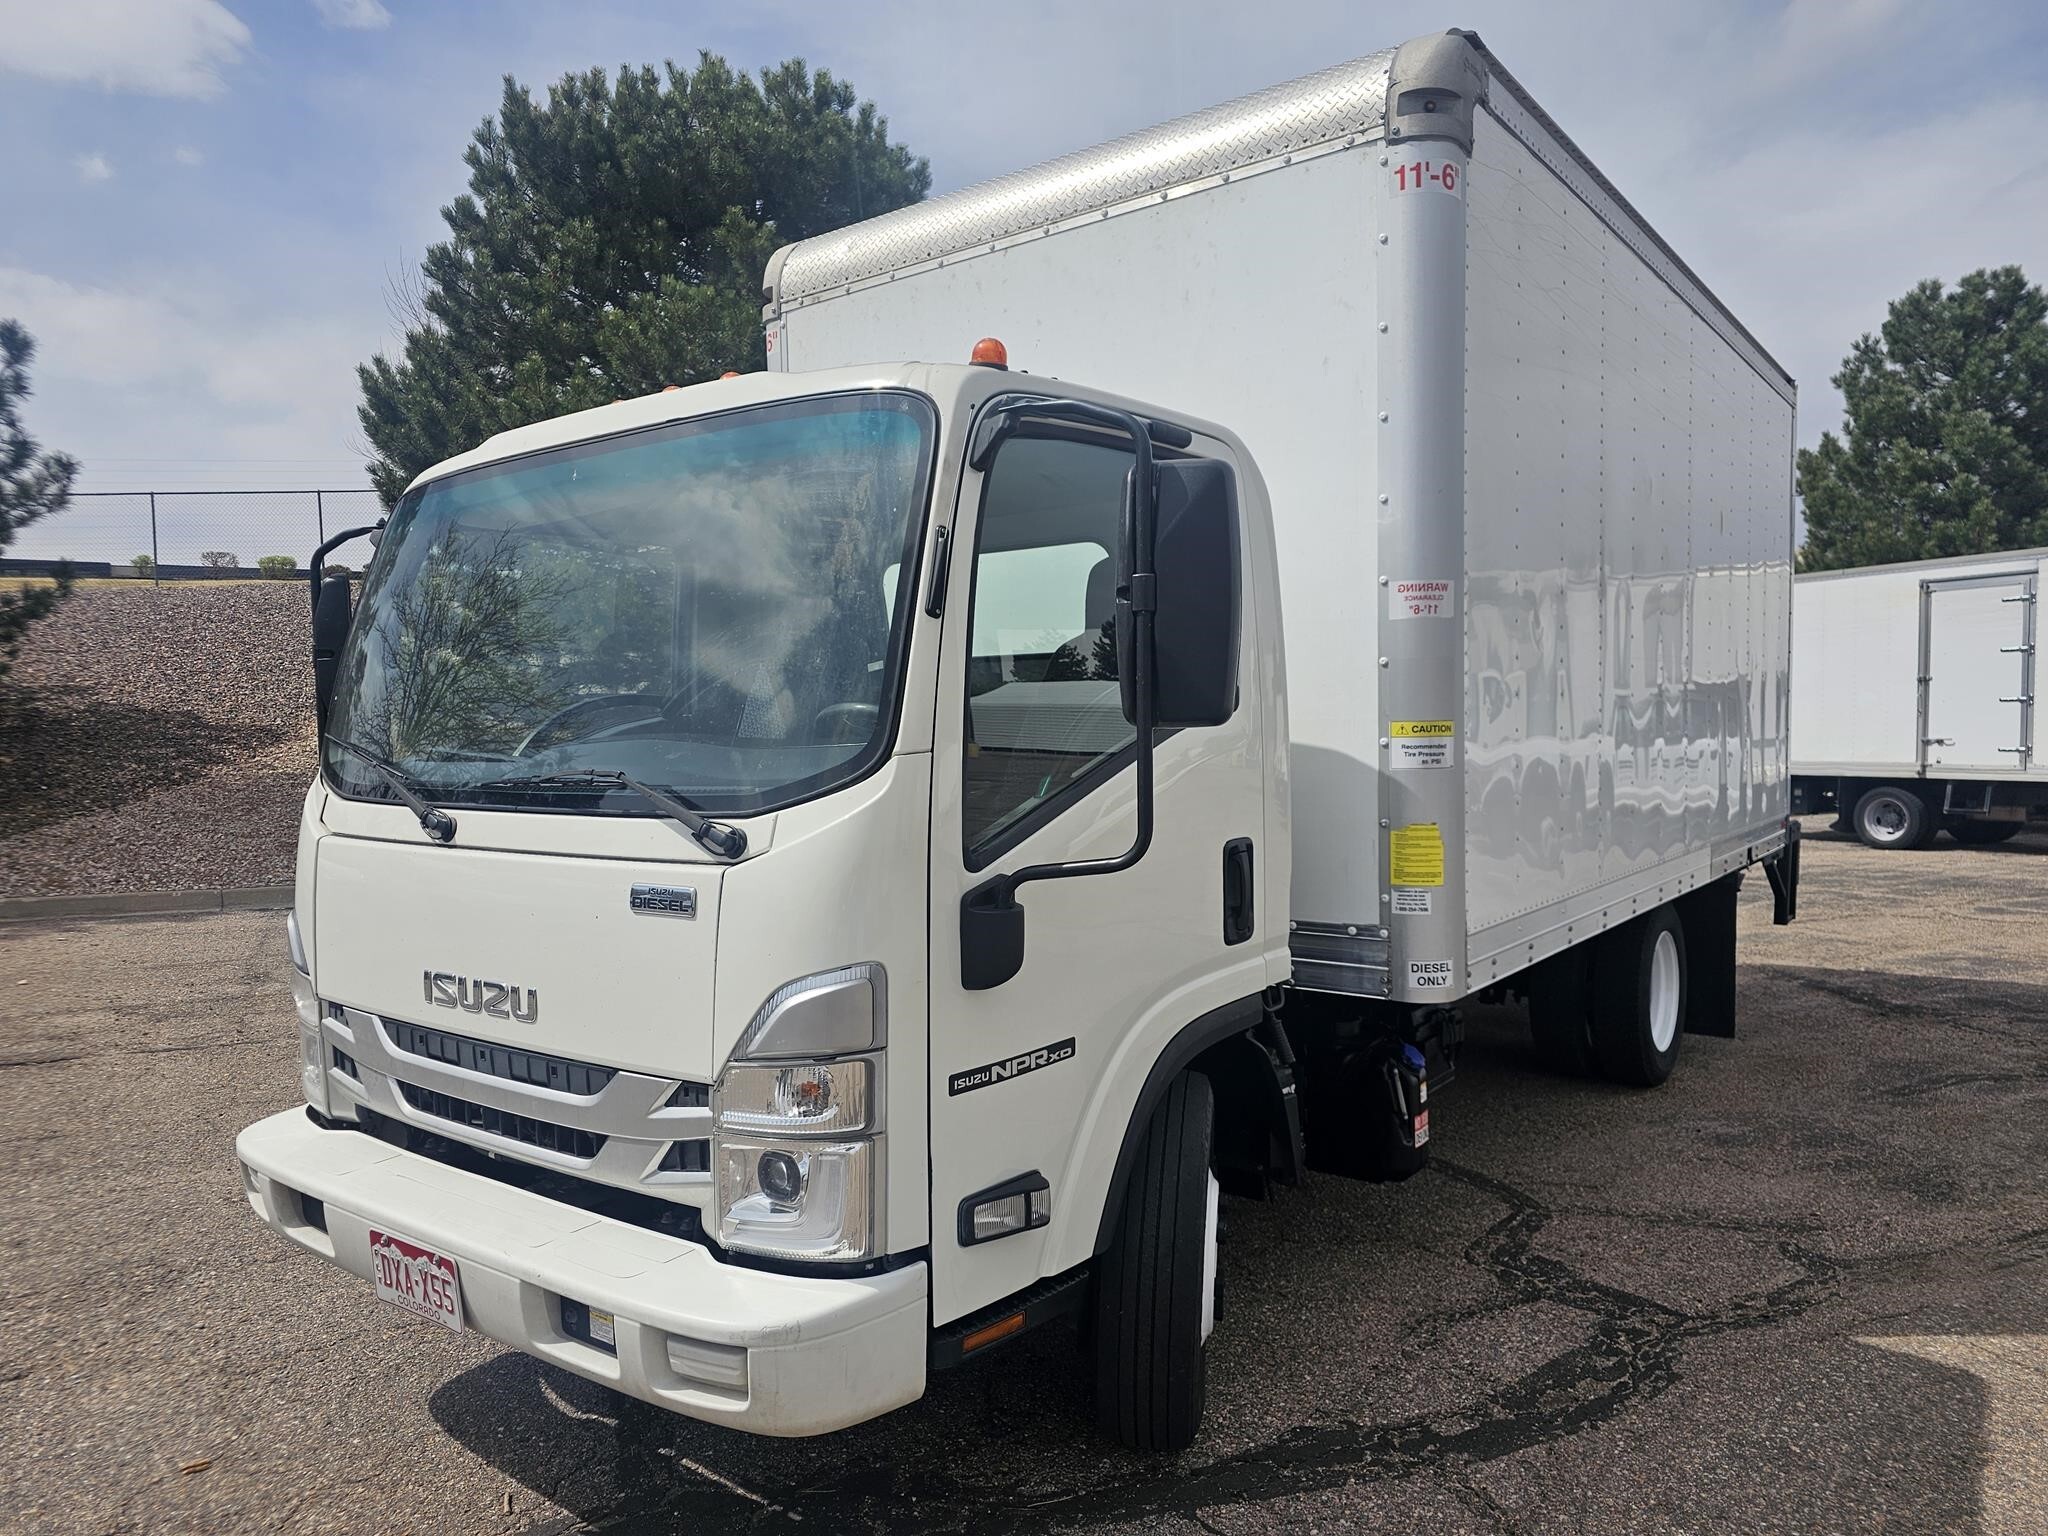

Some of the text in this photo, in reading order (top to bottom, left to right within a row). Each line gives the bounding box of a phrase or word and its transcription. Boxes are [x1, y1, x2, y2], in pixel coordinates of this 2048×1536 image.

[1411, 724, 1452, 734] CAUTION
[1418, 750, 1445, 758] Pressure
[648, 887, 675, 897] ISUZU
[631, 896, 690, 913] DIESEL
[1410, 962, 1452, 974] DIESEL
[1417, 975, 1448, 987] ONLY
[423, 968, 539, 1025] ISUZU
[953, 1071, 990, 1090] ISUZU
[397, 1294, 441, 1321] COLORADO
